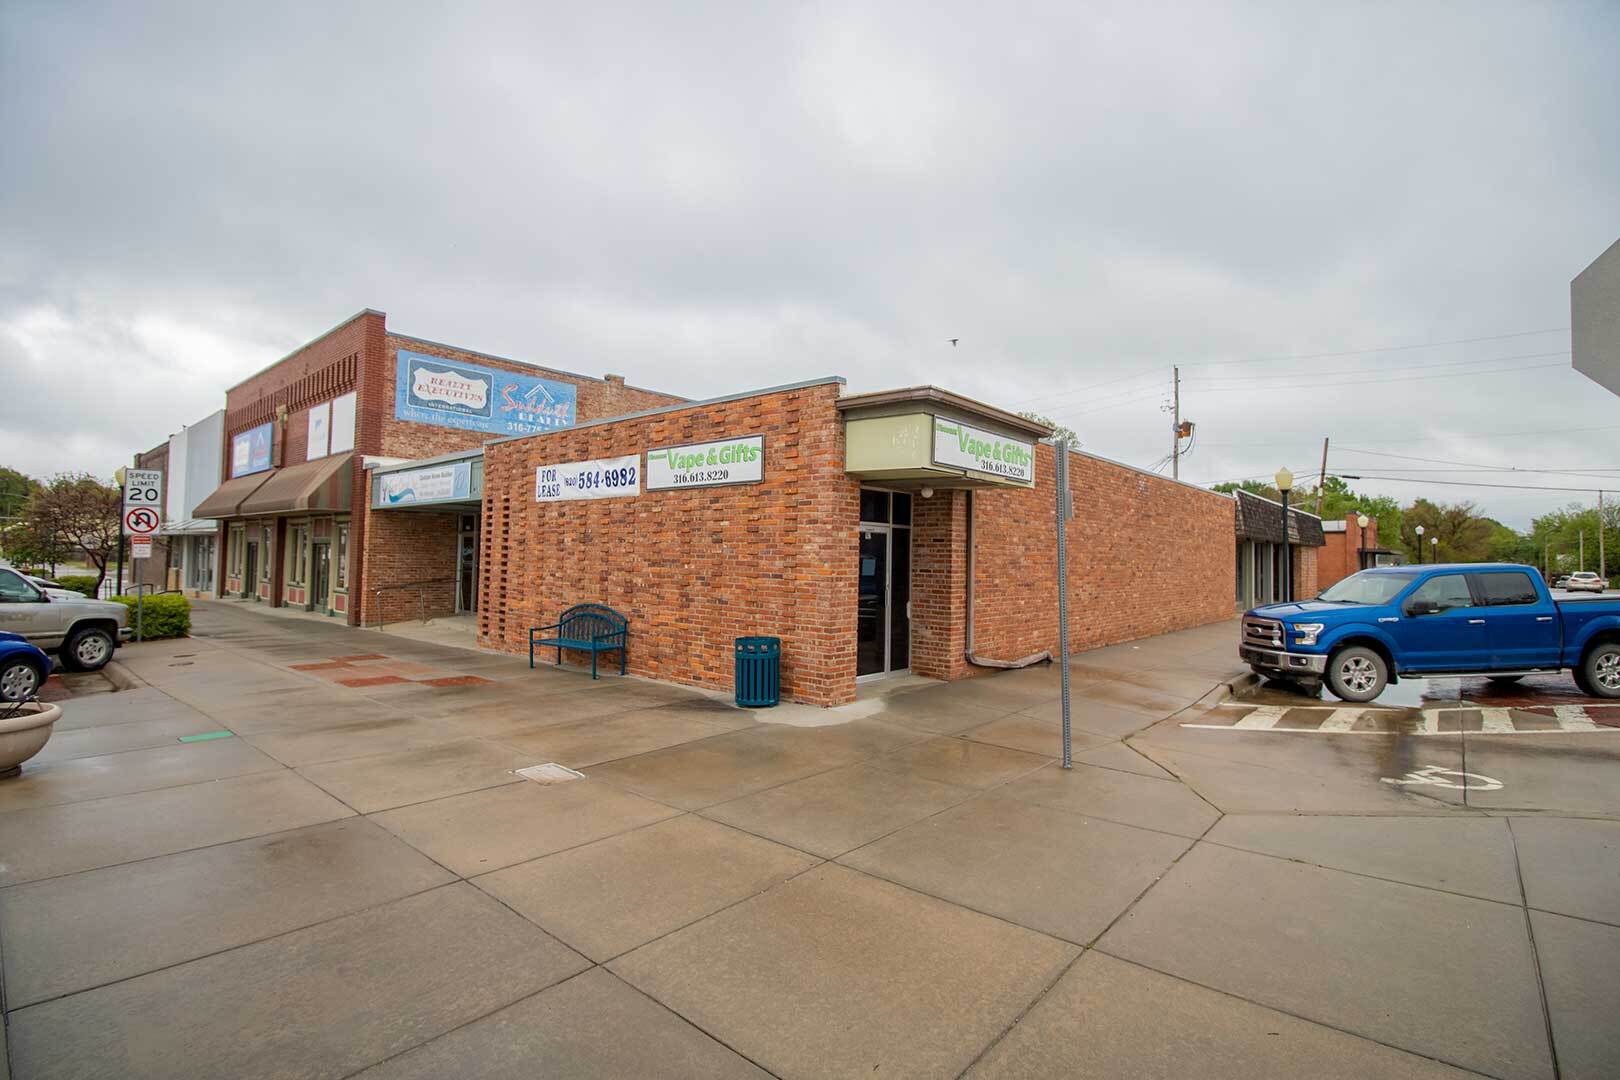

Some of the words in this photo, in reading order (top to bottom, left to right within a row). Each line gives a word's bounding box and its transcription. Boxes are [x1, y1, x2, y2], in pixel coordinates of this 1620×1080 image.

[957, 425, 992, 463] Vape
[992, 440, 1001, 461] &
[1002, 442, 1032, 466] Gifts
[667, 448, 704, 473] Vape
[706, 447, 718, 466] &
[719, 443, 761, 465] Gifts
[980, 459, 1025, 477] 316.613.8220
[129, 472, 160, 481] SPEED
[541, 469, 557, 483] FOR
[578, 467, 637, 490] 584-6982
[673, 469, 729, 484] 316.613.8220
[129, 488, 158, 502] 20
[538, 483, 560, 498] LEASE
